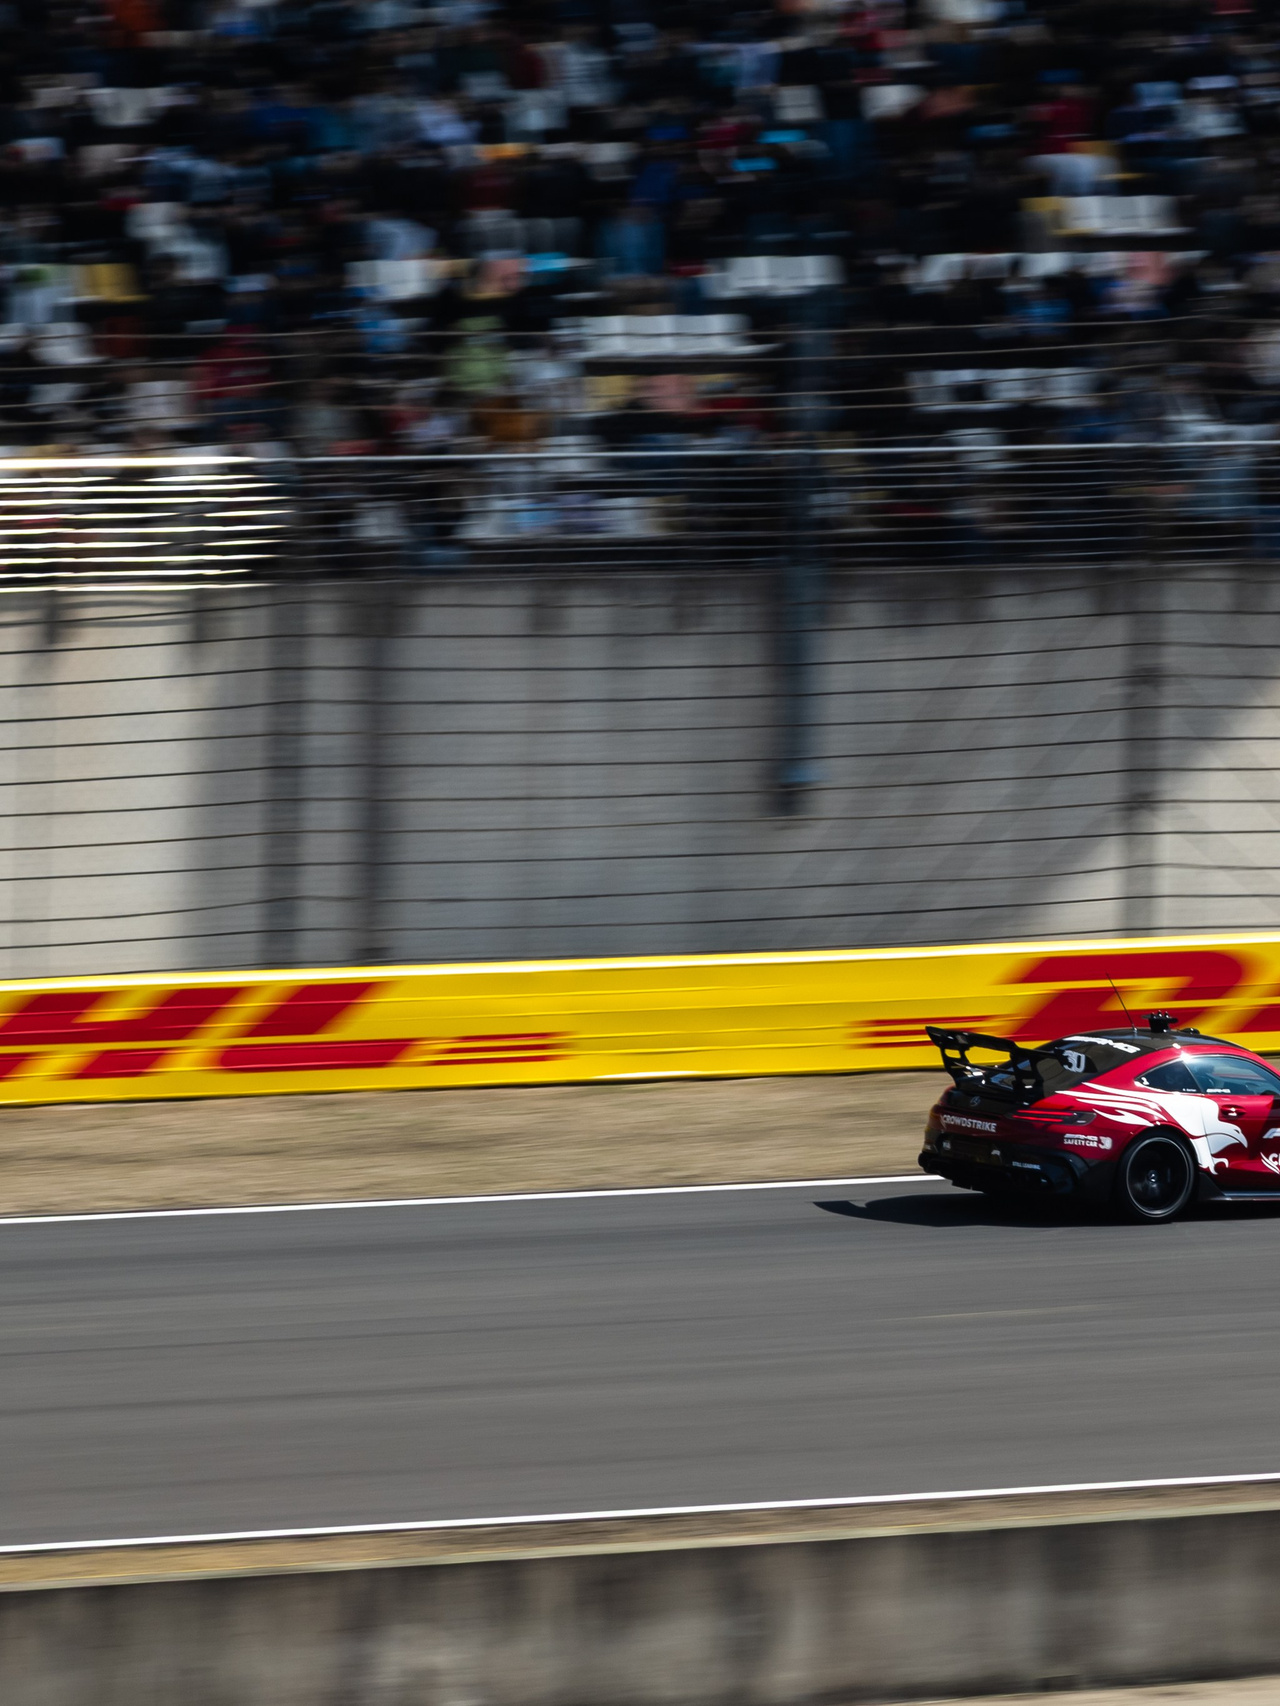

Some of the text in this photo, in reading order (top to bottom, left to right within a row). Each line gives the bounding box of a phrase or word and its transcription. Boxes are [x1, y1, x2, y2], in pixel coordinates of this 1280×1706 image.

[1062, 1050, 1086, 1073] 30
[942, 1114, 998, 1133] CROWDSTRIKE
[1063, 1138, 1098, 1148] SAFETY CAR
